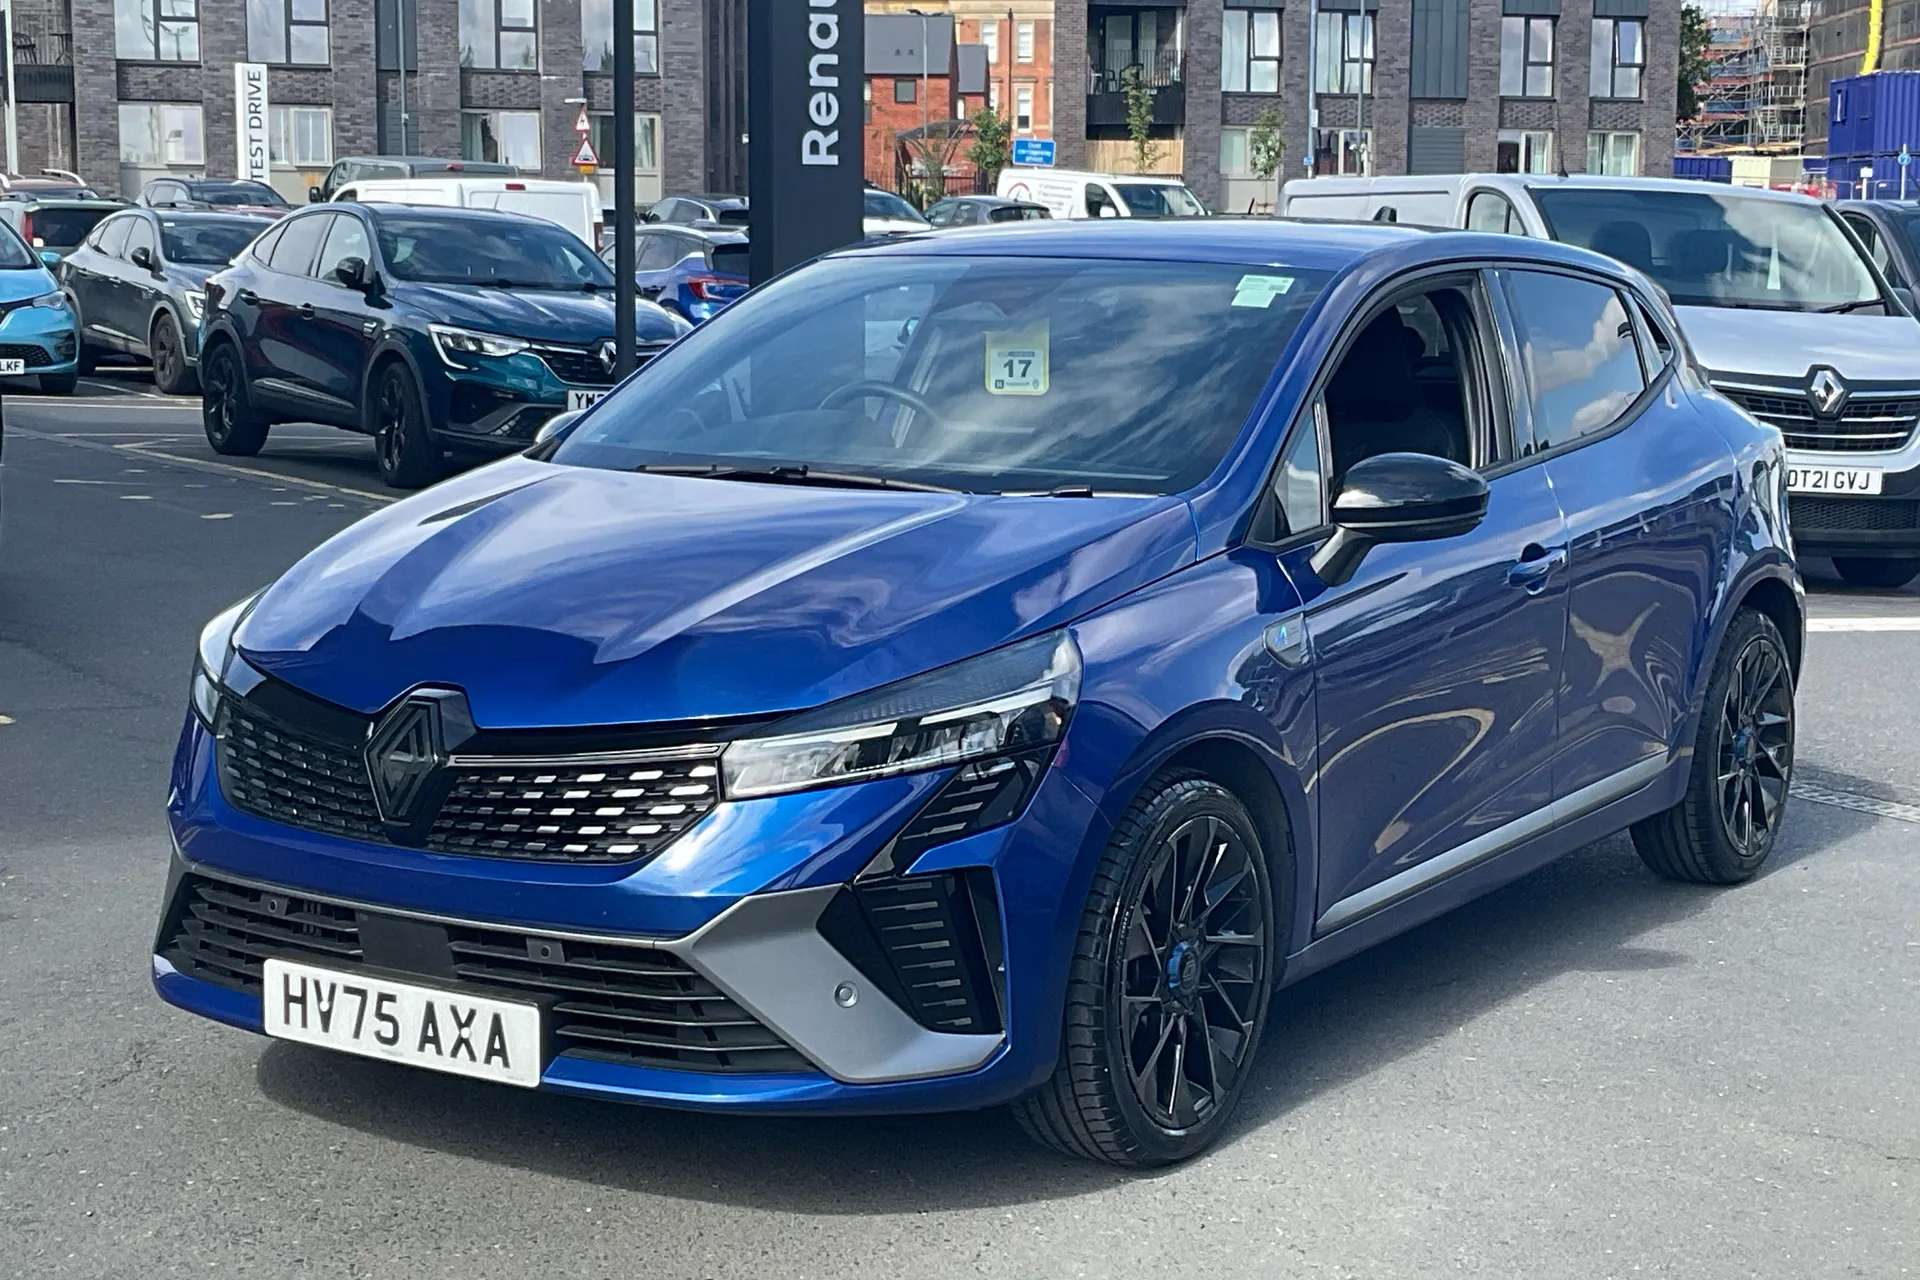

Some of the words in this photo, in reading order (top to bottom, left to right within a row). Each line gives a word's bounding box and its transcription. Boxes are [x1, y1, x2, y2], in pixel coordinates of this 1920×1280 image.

[247, 71, 262, 129] DRIVE
[802, 0, 839, 165] Rena
[249, 135, 263, 180] TEST
[1003, 360, 1032, 377] 17
[1833, 471, 1870, 490] GVJ
[283, 973, 400, 1047] HV75
[417, 1001, 511, 1069] AXA
